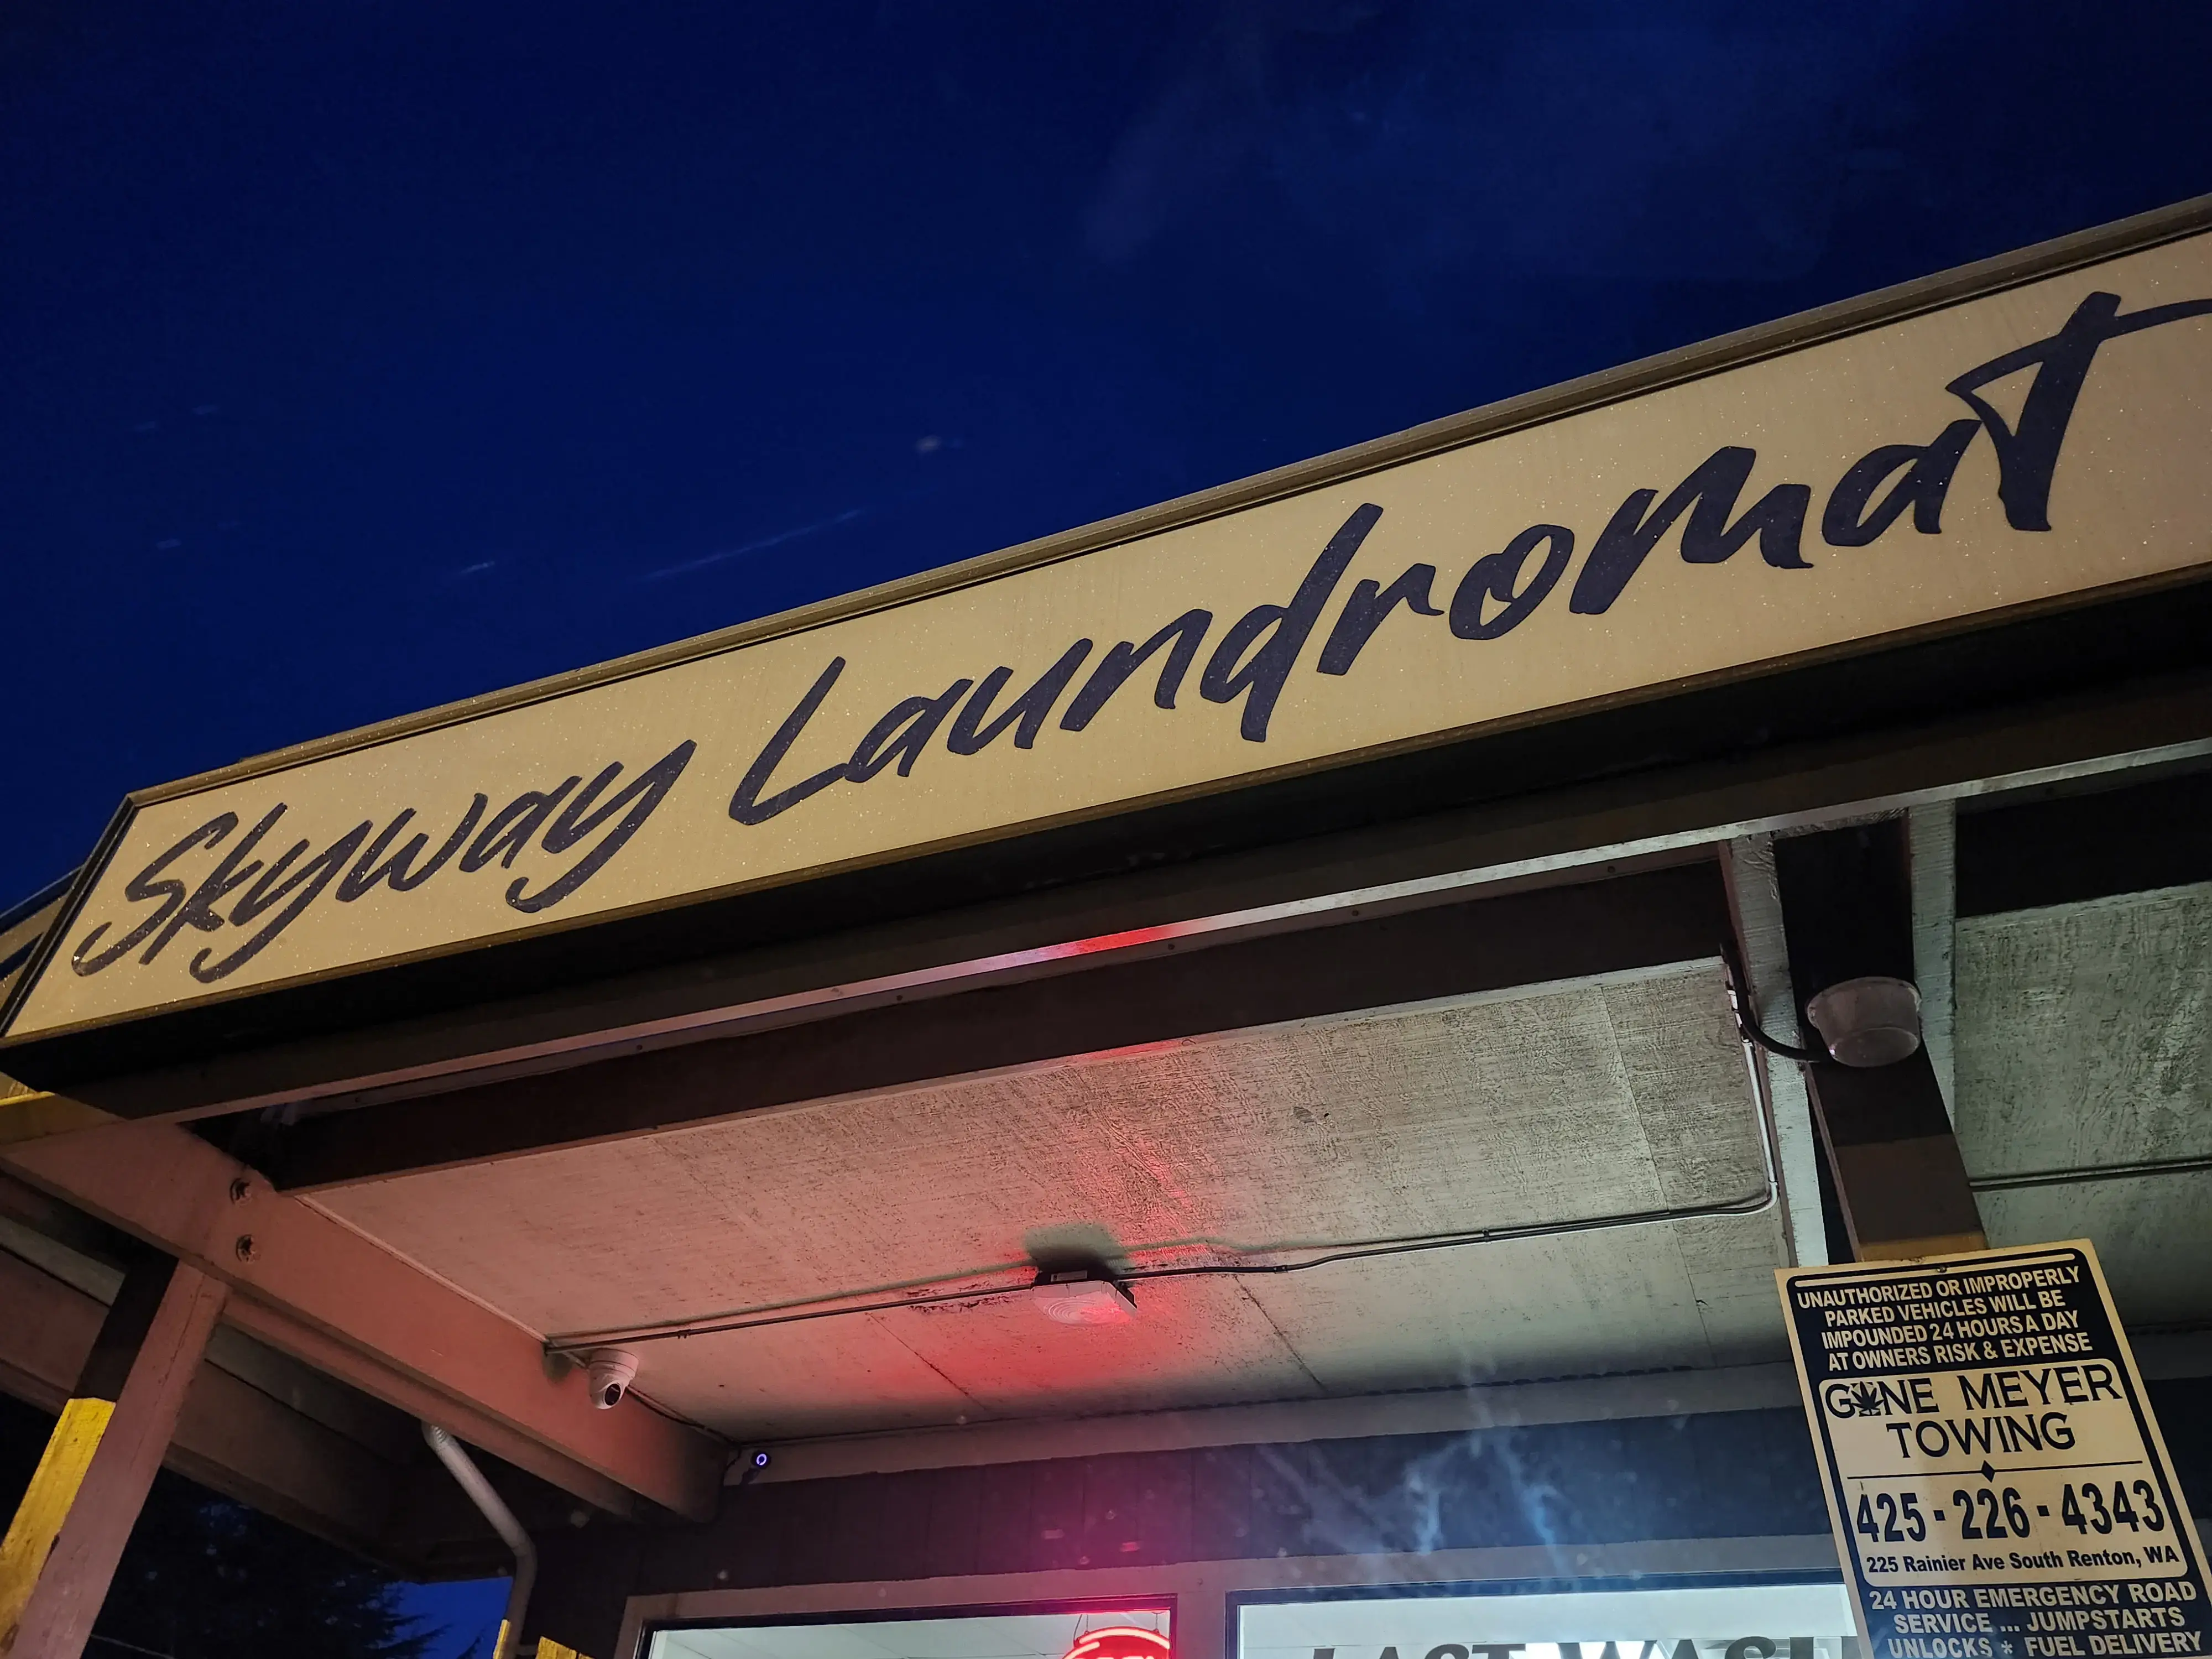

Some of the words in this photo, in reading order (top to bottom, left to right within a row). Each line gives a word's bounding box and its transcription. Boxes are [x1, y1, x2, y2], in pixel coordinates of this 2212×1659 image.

[71, 739, 697, 984] Skyway
[728, 290, 2212, 826] Laundromat
[1797, 1282, 1933, 1309] UNAUTHORIZED
[1936, 1279, 1963, 1297] OR
[1963, 1265, 2080, 1295] IMPROPERLY
[1824, 1306, 1895, 1327] PARKED
[1897, 1297, 1987, 1321] VEHICLES
[1989, 1293, 2037, 1313] WILL
[2038, 1289, 2066, 1308] BE
[1821, 1324, 1928, 1349] IMPOUNDED
[1929, 1322, 1954, 1341] 24
[1956, 1316, 2023, 1339] HOURS
[2025, 1314, 2041, 1333] A
[2041, 1310, 2079, 1331] DAY
[1829, 1352, 1849, 1371] AT
[1852, 1346, 1931, 1370] OWNERS
[1933, 1342, 1981, 1364] RISK
[1983, 1340, 1999, 1360] &
[2000, 1332, 2093, 1358] EXPENSE
[1957, 1364, 2123, 1411] MEYER
[1886, 1411, 2075, 1458] TOWING
[1866, 1556, 1899, 1573] 225
[1903, 1554, 1966, 1572] Rainier
[1972, 1554, 2005, 1570] Ave
[2010, 1550, 2063, 1569] South
[2067, 1548, 2142, 1569] Renton,
[2144, 1545, 2179, 1565] WA
[1869, 1590, 1897, 1610] 24
[1901, 1589, 1970, 1610] HOUR
[1973, 1584, 2119, 1608] EMERGENCY
[2127, 1581, 2197, 1604] ROAD
[1893, 1613, 1993, 1634] SERVICE
[2026, 1606, 2185, 1632] JUMPSTARTS
[1887, 1637, 1993, 1658] UNLOCKS
[2023, 1636, 2086, 1657] FUEL
[2088, 1631, 2202, 1656] DELIVERY
